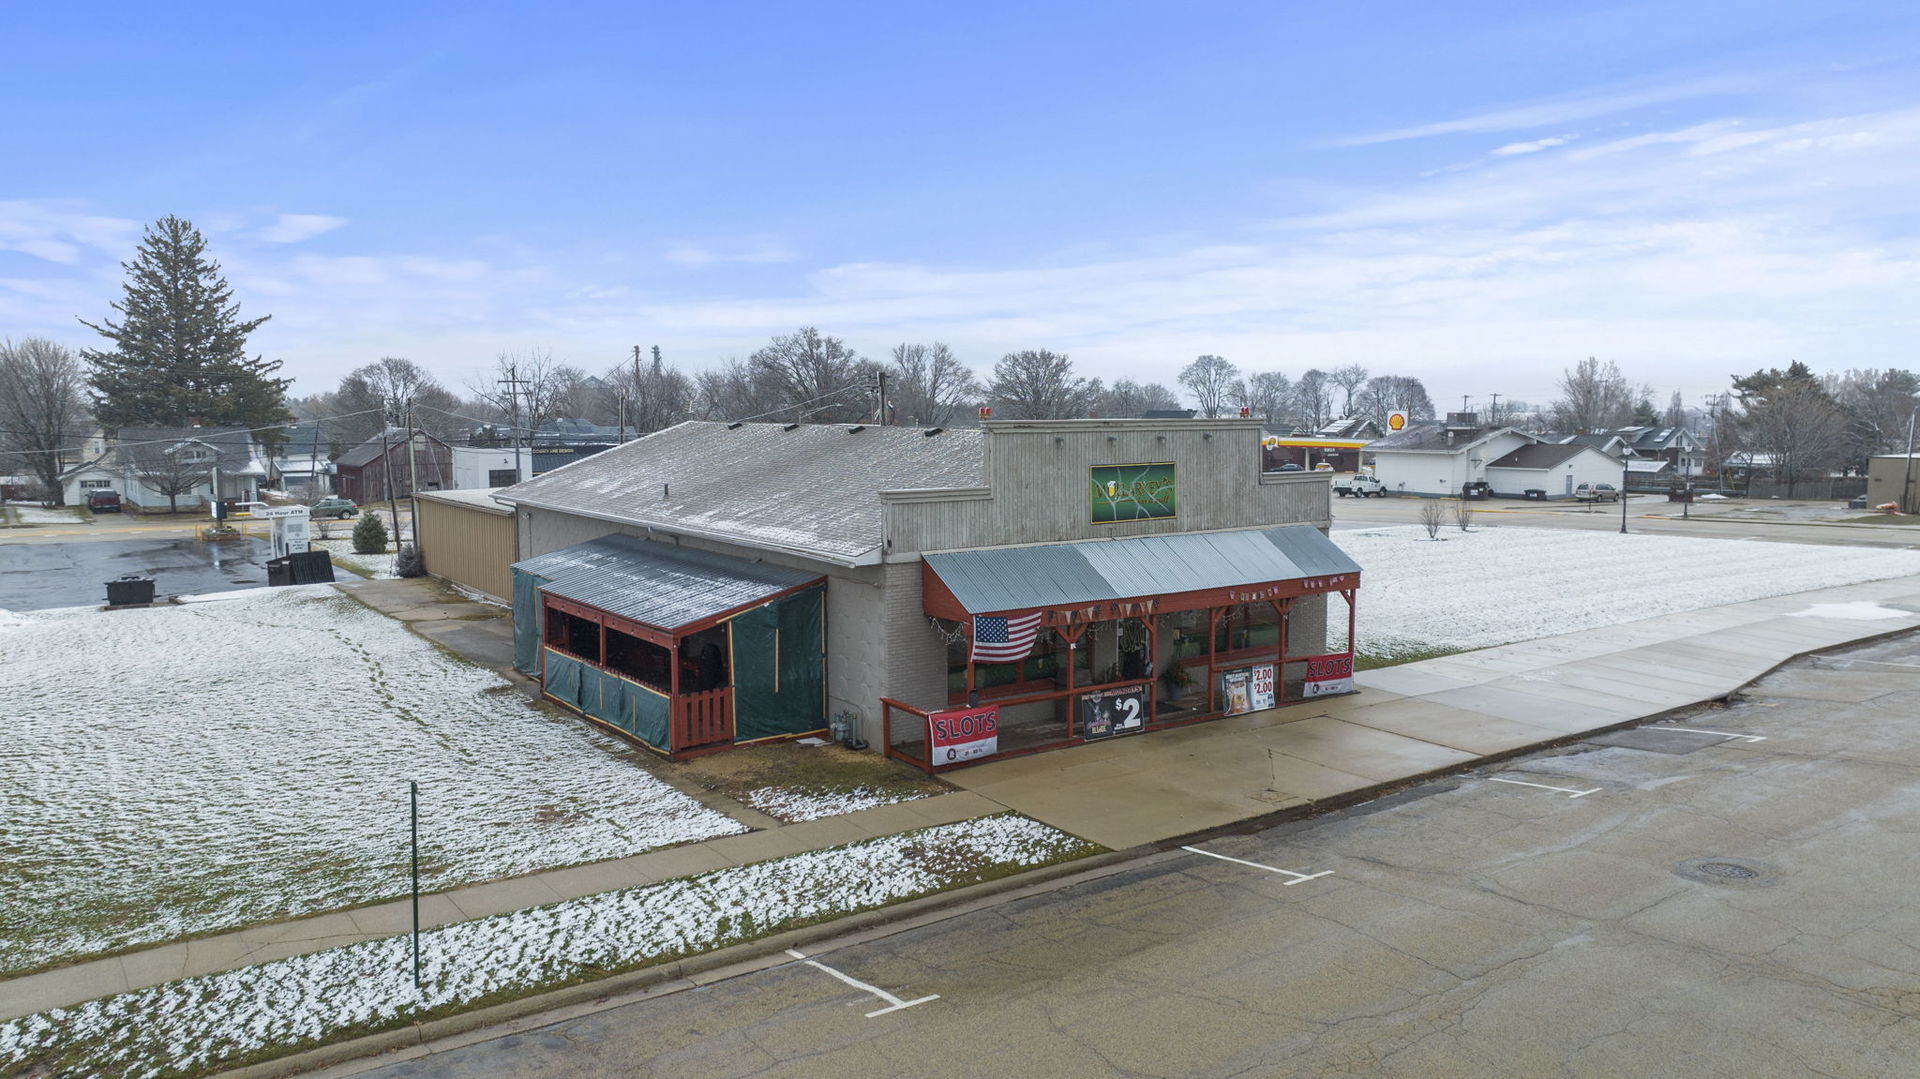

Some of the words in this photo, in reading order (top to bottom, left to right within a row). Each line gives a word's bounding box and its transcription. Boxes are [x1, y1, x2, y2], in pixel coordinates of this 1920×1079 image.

[1254, 668, 1272, 681] $2.00
[1308, 658, 1352, 677] SLOTS
[1254, 681, 1272, 694] $2.00
[1115, 697, 1141, 729] $2
[936, 711, 996, 740] SLOTS
